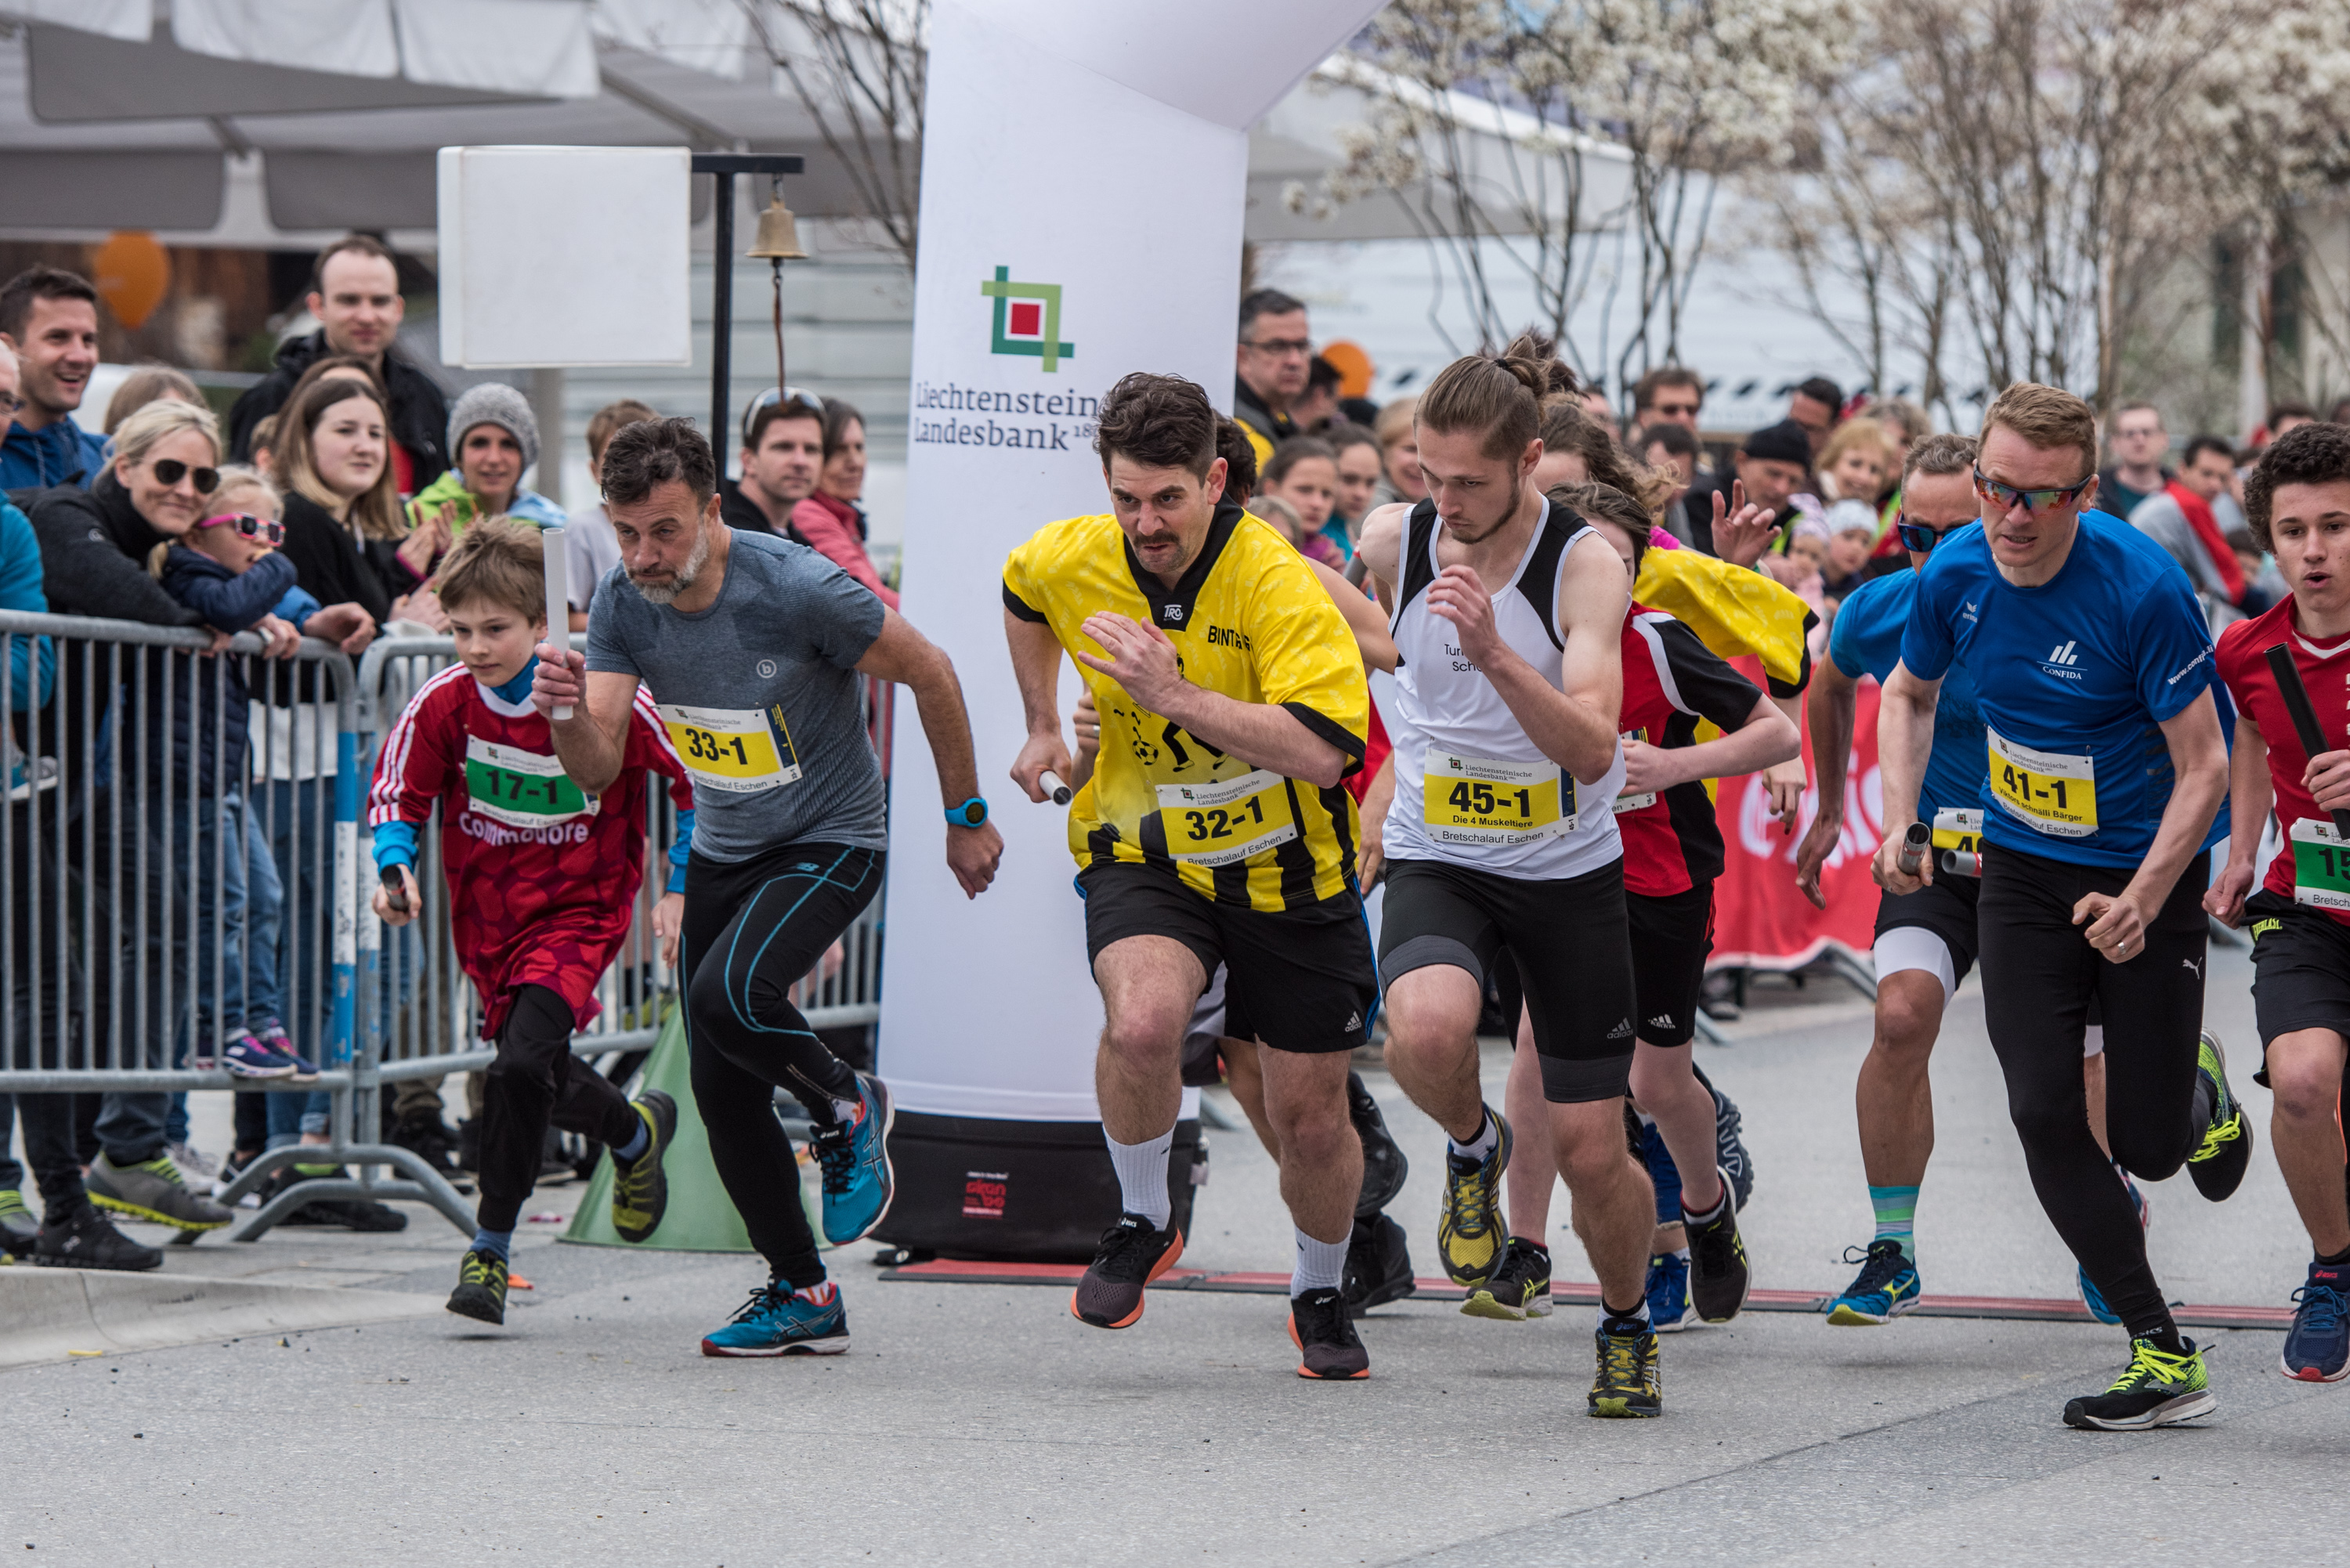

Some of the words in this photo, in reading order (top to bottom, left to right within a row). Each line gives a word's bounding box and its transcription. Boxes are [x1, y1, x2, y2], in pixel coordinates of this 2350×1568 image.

[916, 381, 1097, 417] Liechtenstein
[915, 417, 1070, 451] Landesbank
[2043, 666, 2082, 680] CONFIDA
[685, 728, 748, 765] 33-1
[1465, 764, 1533, 778] Liechtensteinische
[1466, 771, 1509, 781] Landesbank
[486, 769, 558, 804] 17-1
[734, 781, 768, 790] Eschen
[1196, 780, 1260, 800] Liechtensteinische
[2003, 764, 2068, 810] 41-1
[1198, 793, 1238, 805] Landesbank
[1448, 781, 1531, 818] 45-1
[1998, 786, 2020, 805] Viktors
[2052, 810, 2083, 822] Bärger
[1185, 796, 1264, 841] 32-1
[1479, 818, 1533, 828] Muskeltiere
[1442, 831, 1505, 843] Bretschalauf
[1507, 832, 1544, 844] Eschen
[2047, 824, 2082, 836] Eschen
[1248, 836, 1282, 854] Eschen
[2313, 894, 2350, 908] Bretsch
